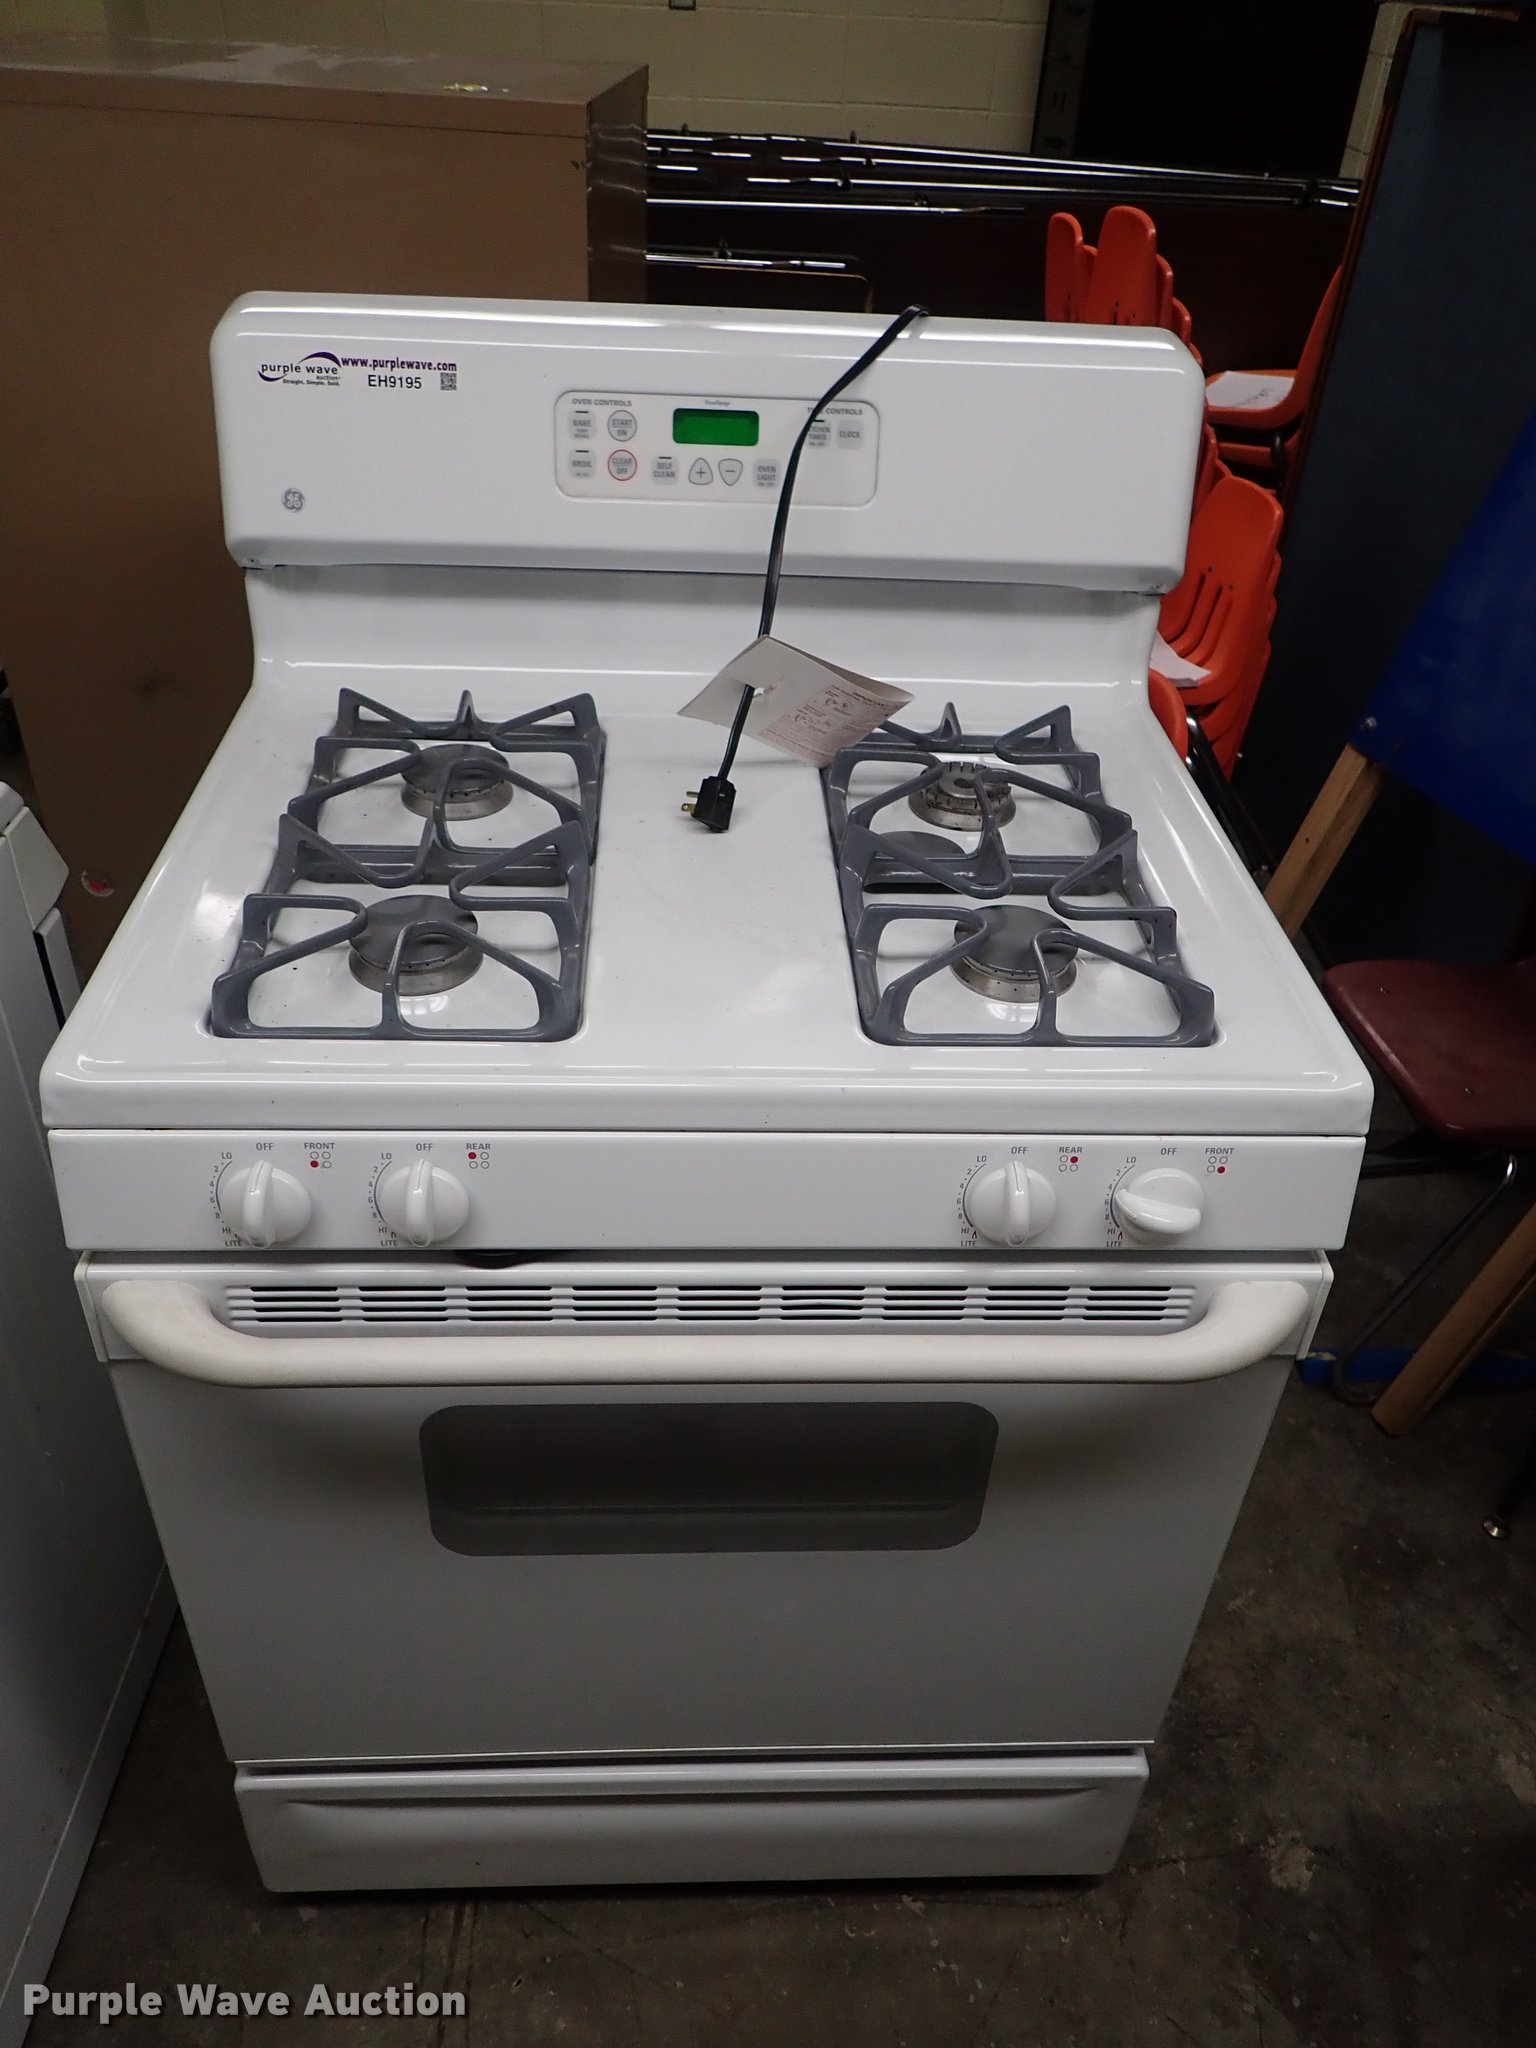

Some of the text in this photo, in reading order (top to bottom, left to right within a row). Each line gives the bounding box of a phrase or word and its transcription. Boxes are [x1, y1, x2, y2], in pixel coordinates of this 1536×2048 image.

[341, 357, 457, 372] www.purplewave.com
[261, 363, 338, 375] purple wave
[368, 374, 422, 389] EH9195
[594, 399, 632, 407] CONTROLS
[572, 419, 591, 427] BAKE
[612, 457, 632, 465] CLEAR
[757, 465, 776, 473] OVEN
[653, 470, 675, 478] CLEAN
[256, 1142, 274, 1151] OFF
[304, 1142, 335, 1150] FRONT
[416, 1143, 433, 1151] OFF
[1011, 1146, 1028, 1154] OFF
[1160, 1147, 1178, 1155] OFF
[1205, 1147, 1235, 1155] FRONT
[381, 1152, 392, 1160] LO
